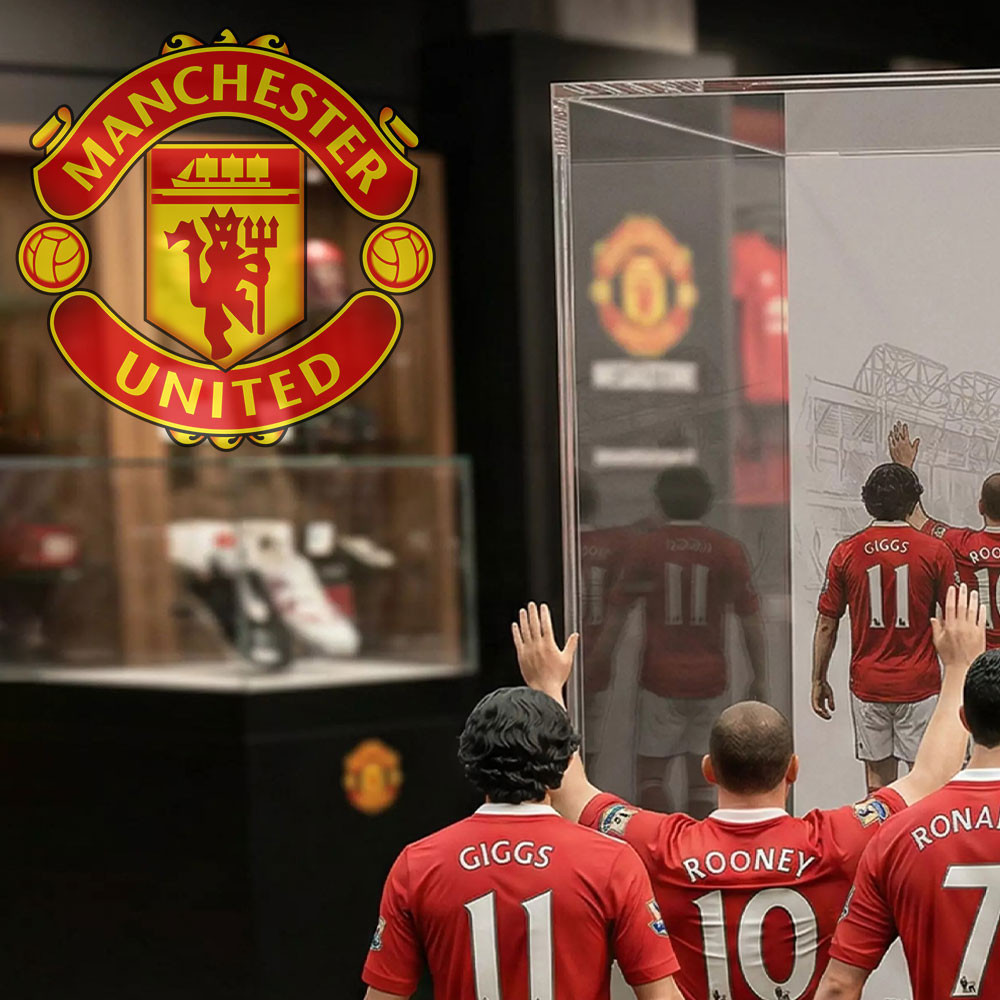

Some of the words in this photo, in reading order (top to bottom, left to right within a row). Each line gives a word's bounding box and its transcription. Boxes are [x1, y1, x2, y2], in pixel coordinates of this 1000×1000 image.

[864, 538, 910, 554] GIGGS
[866, 564, 910, 628] 11
[459, 840, 555, 871] GIGGS
[682, 847, 816, 883] ROONEY
